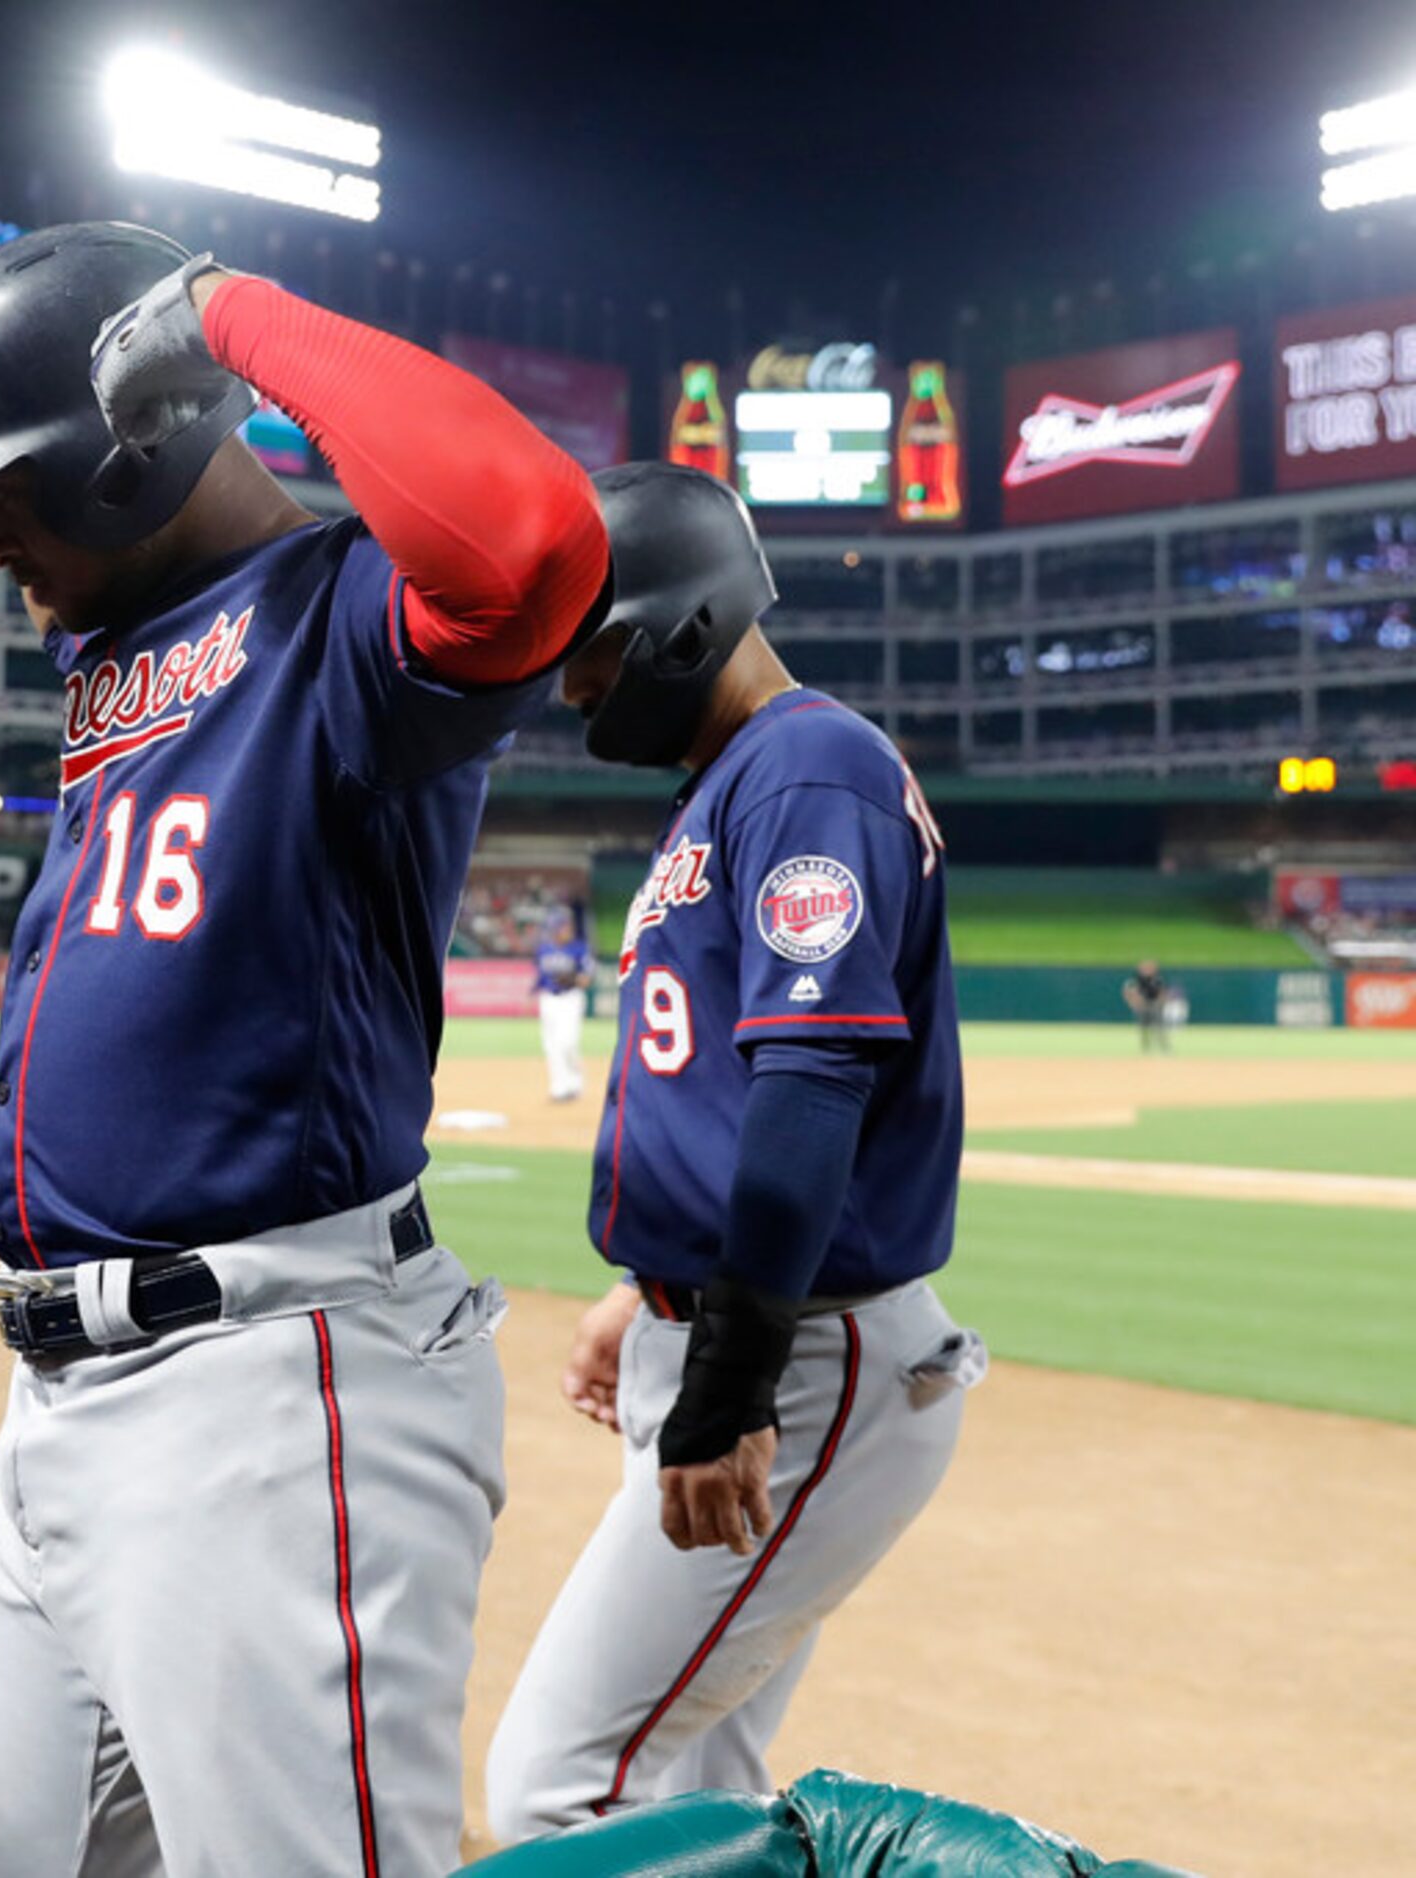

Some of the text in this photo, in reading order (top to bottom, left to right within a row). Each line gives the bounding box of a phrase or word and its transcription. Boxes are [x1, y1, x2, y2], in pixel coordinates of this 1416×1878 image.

[1283, 330, 1391, 399] THIS
[1286, 391, 1378, 455] FOR
[84, 789, 210, 942] 16
[761, 887, 854, 930] Twins
[638, 964, 696, 1077] 9
